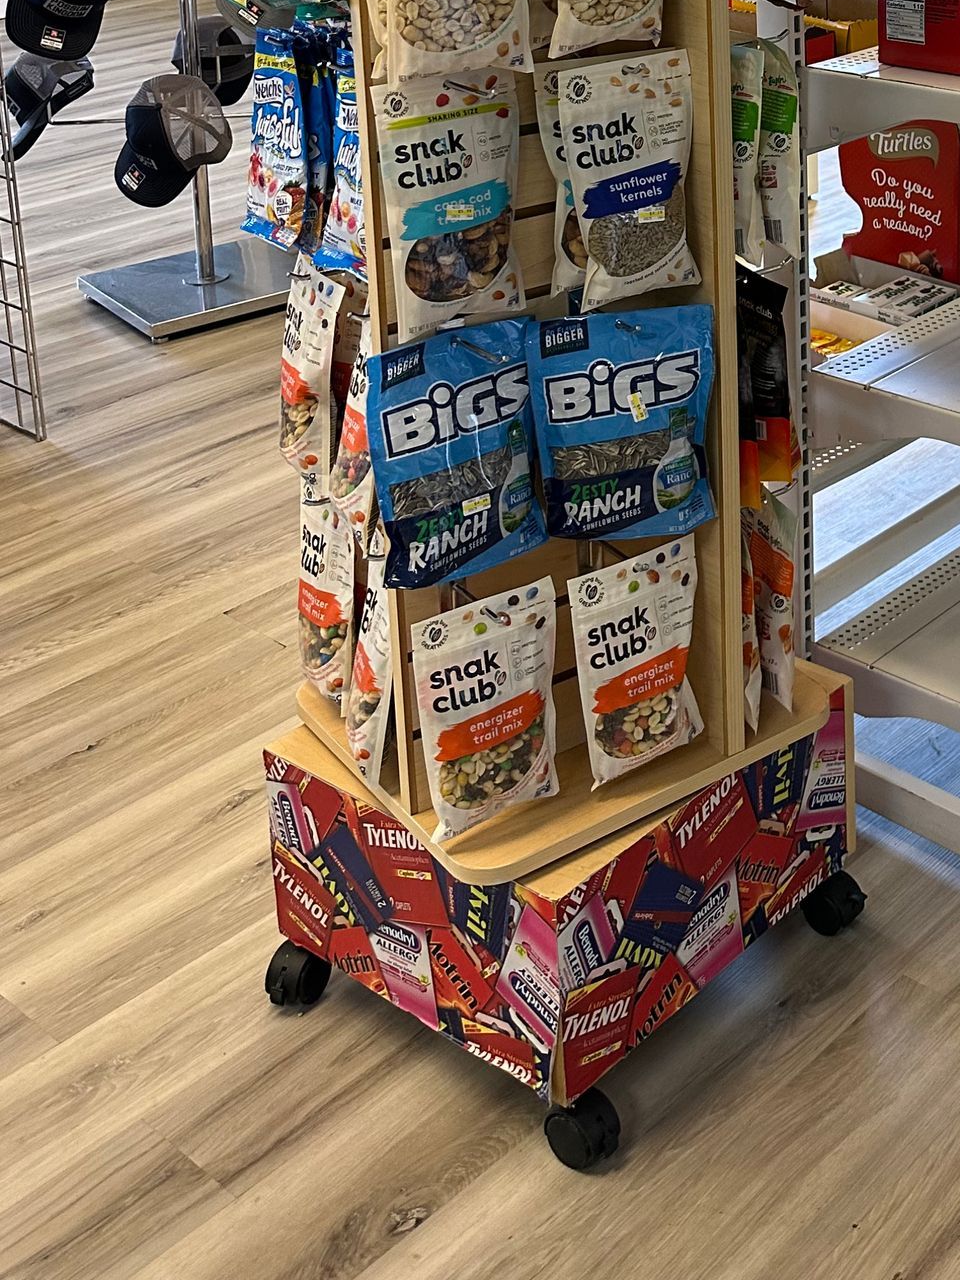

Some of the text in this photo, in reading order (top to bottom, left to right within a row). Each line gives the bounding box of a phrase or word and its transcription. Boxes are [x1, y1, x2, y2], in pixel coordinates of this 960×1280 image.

[565, 91, 593, 105] GREATNESS
[427, 107, 479, 123] SHARING SIZE
[572, 112, 638, 144] snak
[394, 129, 467, 164] snak
[575, 139, 635, 170] club
[869, 131, 933, 156] Turtles
[397, 157, 463, 190] club
[609, 170, 668, 194] sunflower
[871, 168, 936, 201] Do you
[468, 191, 492, 207] cod
[620, 185, 663, 204] kernels
[862, 190, 943, 227] really need
[872, 216, 933, 242] a reason?
[883, 279, 922, 300] Junior
[911, 286, 948, 308] Junior
[545, 329, 585, 349] BIGGER
[387, 354, 420, 381] BIGGER
[570, 477, 620, 505] ZESTY
[564, 484, 642, 528] RANCH
[582, 507, 642, 532] SUNFLOWER SEEDS
[408, 510, 489, 574] RANCH
[429, 534, 488, 572] SUNFLOWER SEEDS
[578, 591, 605, 608] GREATNESS
[587, 605, 651, 648] snak
[420, 633, 449, 651] GREATNESS
[589, 633, 647, 670] club
[429, 649, 501, 690] snak
[623, 659, 675, 687] energizer
[432, 677, 497, 714] club
[626, 672, 675, 698] trail mix
[469, 704, 524, 733] energizer
[473, 718, 523, 745] trail mix
[811, 790, 846, 808] Benadryl
[272, 857, 334, 929] TYLENOL
[375, 938, 420, 963] ALLERGY
[562, 996, 631, 1043] TYLENOL
